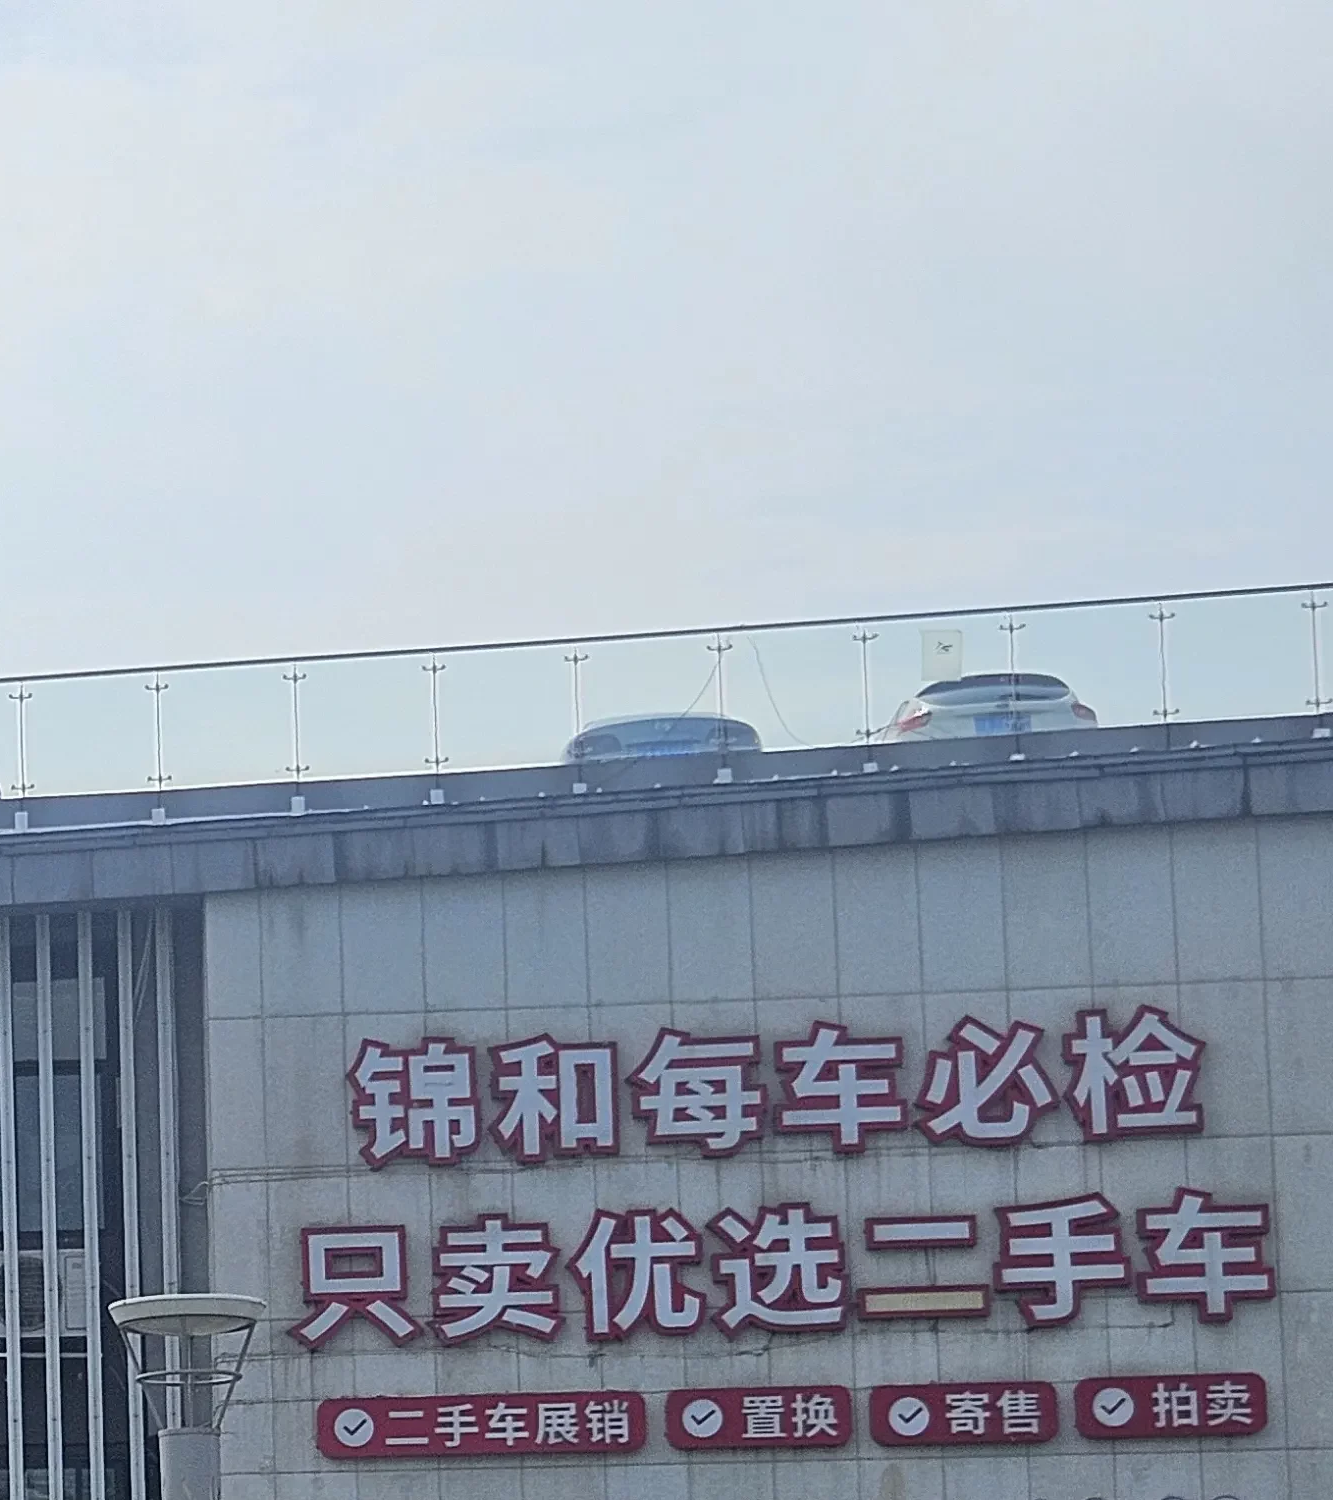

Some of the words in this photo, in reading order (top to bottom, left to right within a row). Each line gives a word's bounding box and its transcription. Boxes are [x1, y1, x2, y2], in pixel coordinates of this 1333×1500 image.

[351, 1006, 1205, 1166] 锦和每车必检
[292, 1189, 1274, 1346] 只卖优选二手车
[385, 1401, 630, 1447] 二手车展销
[741, 1394, 838, 1440] 置换
[944, 1390, 1042, 1436] 寄售
[1151, 1380, 1254, 1428] 拍卖
